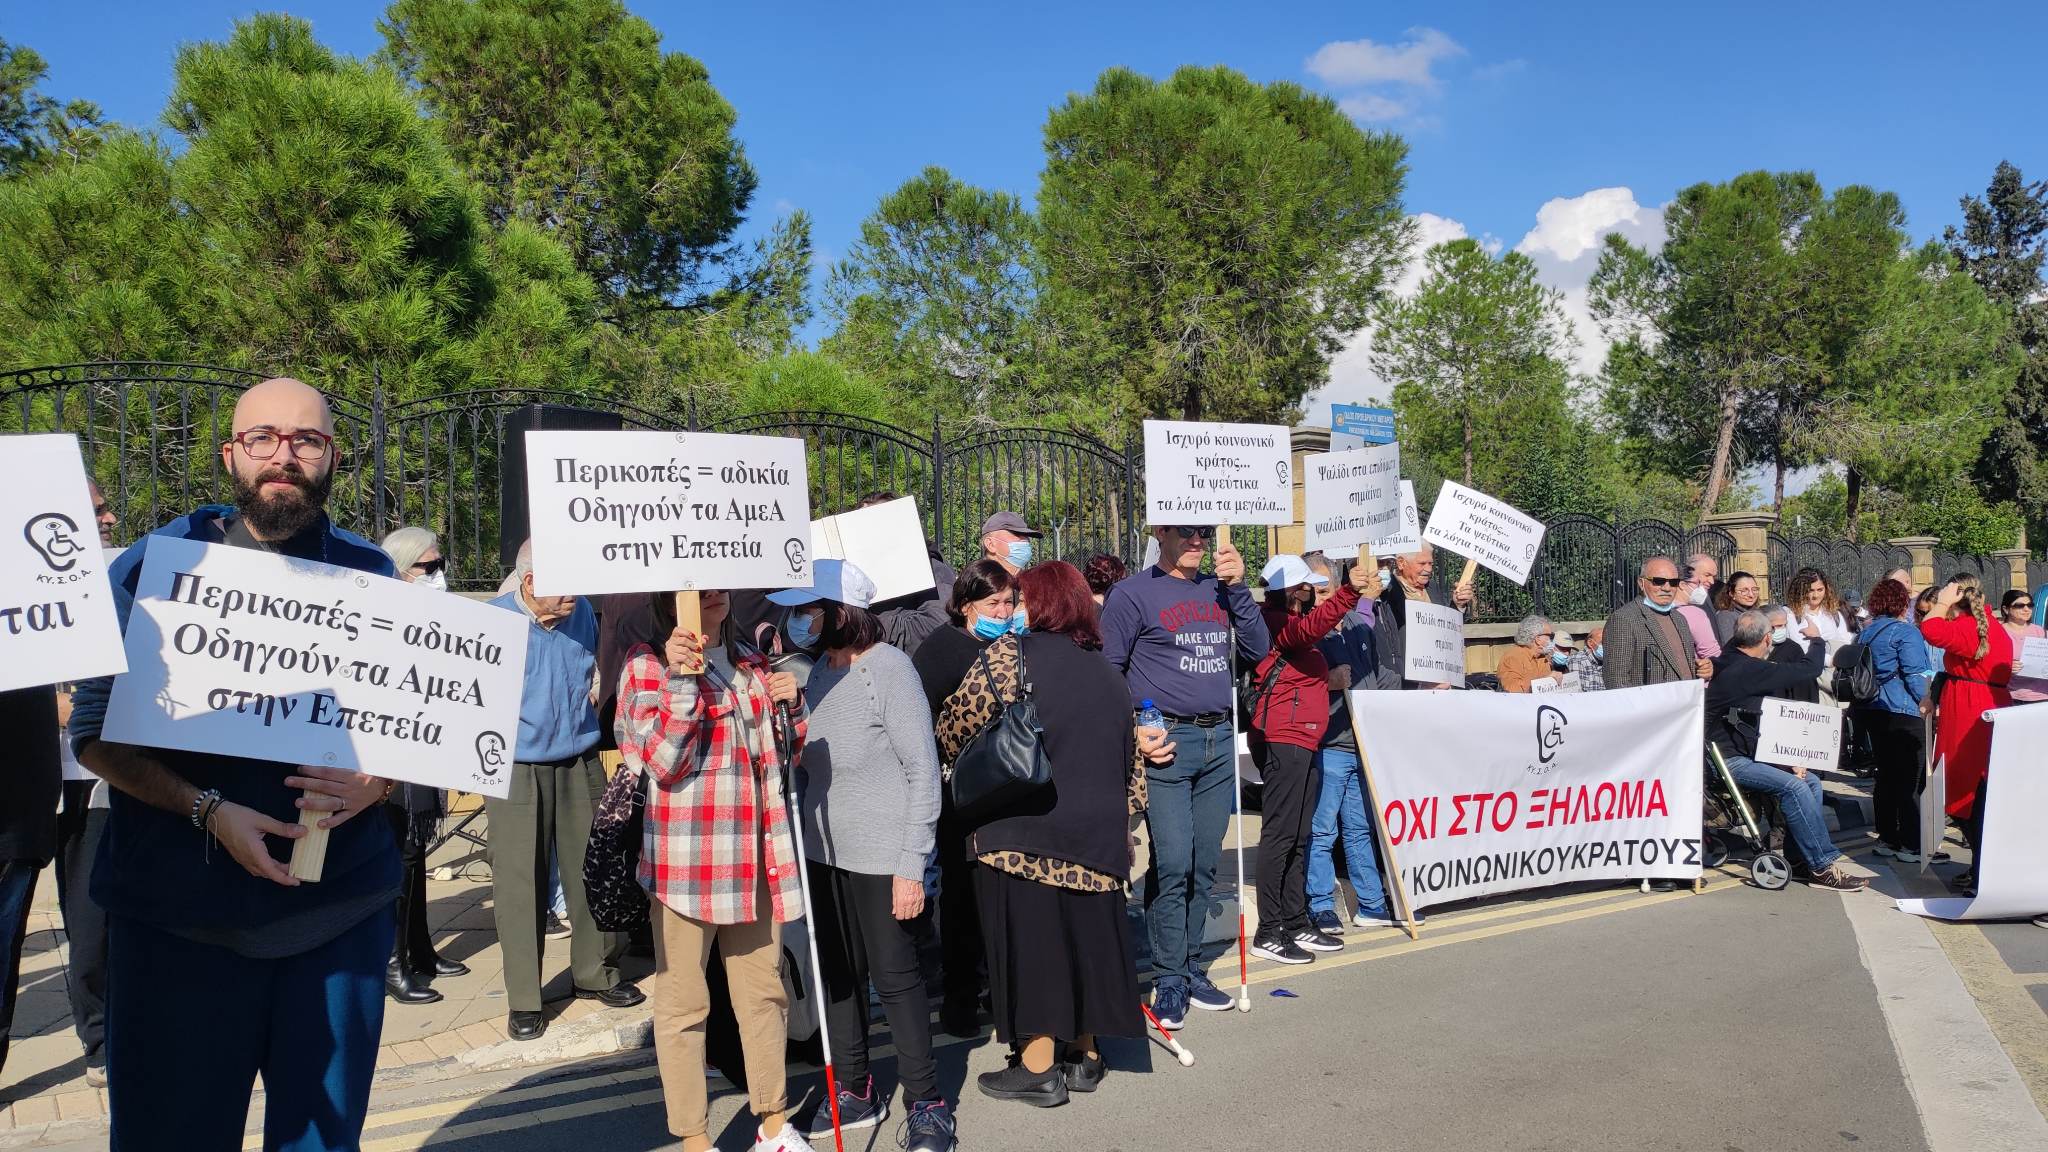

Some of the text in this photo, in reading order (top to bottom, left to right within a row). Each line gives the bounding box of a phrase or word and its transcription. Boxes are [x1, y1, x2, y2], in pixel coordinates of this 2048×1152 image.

[1166, 430, 1274, 449] Ισχυρό κοινωνικό
[1195, 452, 1250, 471] κράτος...
[1318, 463, 1350, 481] Ψαλίδι
[1352, 465, 1367, 477] στα
[554, 457, 790, 490] Περικοπές = αδικία
[1188, 474, 1259, 492] Τα ψεύτικα
[1157, 496, 1286, 514] τα λόγια τα μεγάλα...
[1349, 485, 1382, 506] σημαίνει
[568, 495, 786, 529] Οδηγούν τα ΑμεΑ
[1452, 489, 1532, 534] Ισχυρό κοινωνικό
[1315, 515, 1346, 538] ψαλίδι
[1348, 517, 1364, 529] στα
[1459, 521, 1511, 552] Τα ψεύτικα
[602, 533, 763, 567] στην Επετεία
[1429, 526, 1441, 536] τα
[1443, 529, 1471, 546] λόγια
[1473, 544, 1485, 555] τα
[168, 571, 502, 667] Περικοπές = αδικία
[1175, 632, 1203, 646] MAKE
[1204, 631, 1227, 644] YOUR
[1195, 645, 1215, 657] OWN
[174, 623, 486, 708] Οδηγούν τα ΑμεΑ
[1180, 656, 1228, 674] CHOICES
[207, 687, 444, 747] στην Επετεία
[1780, 705, 1831, 724] Επιδόματα
[1772, 742, 1829, 760] Δικαιώματα
[1384, 779, 1669, 846] ΟΧΙ ΣΤΟ ΞΗΛΩΜΑ
